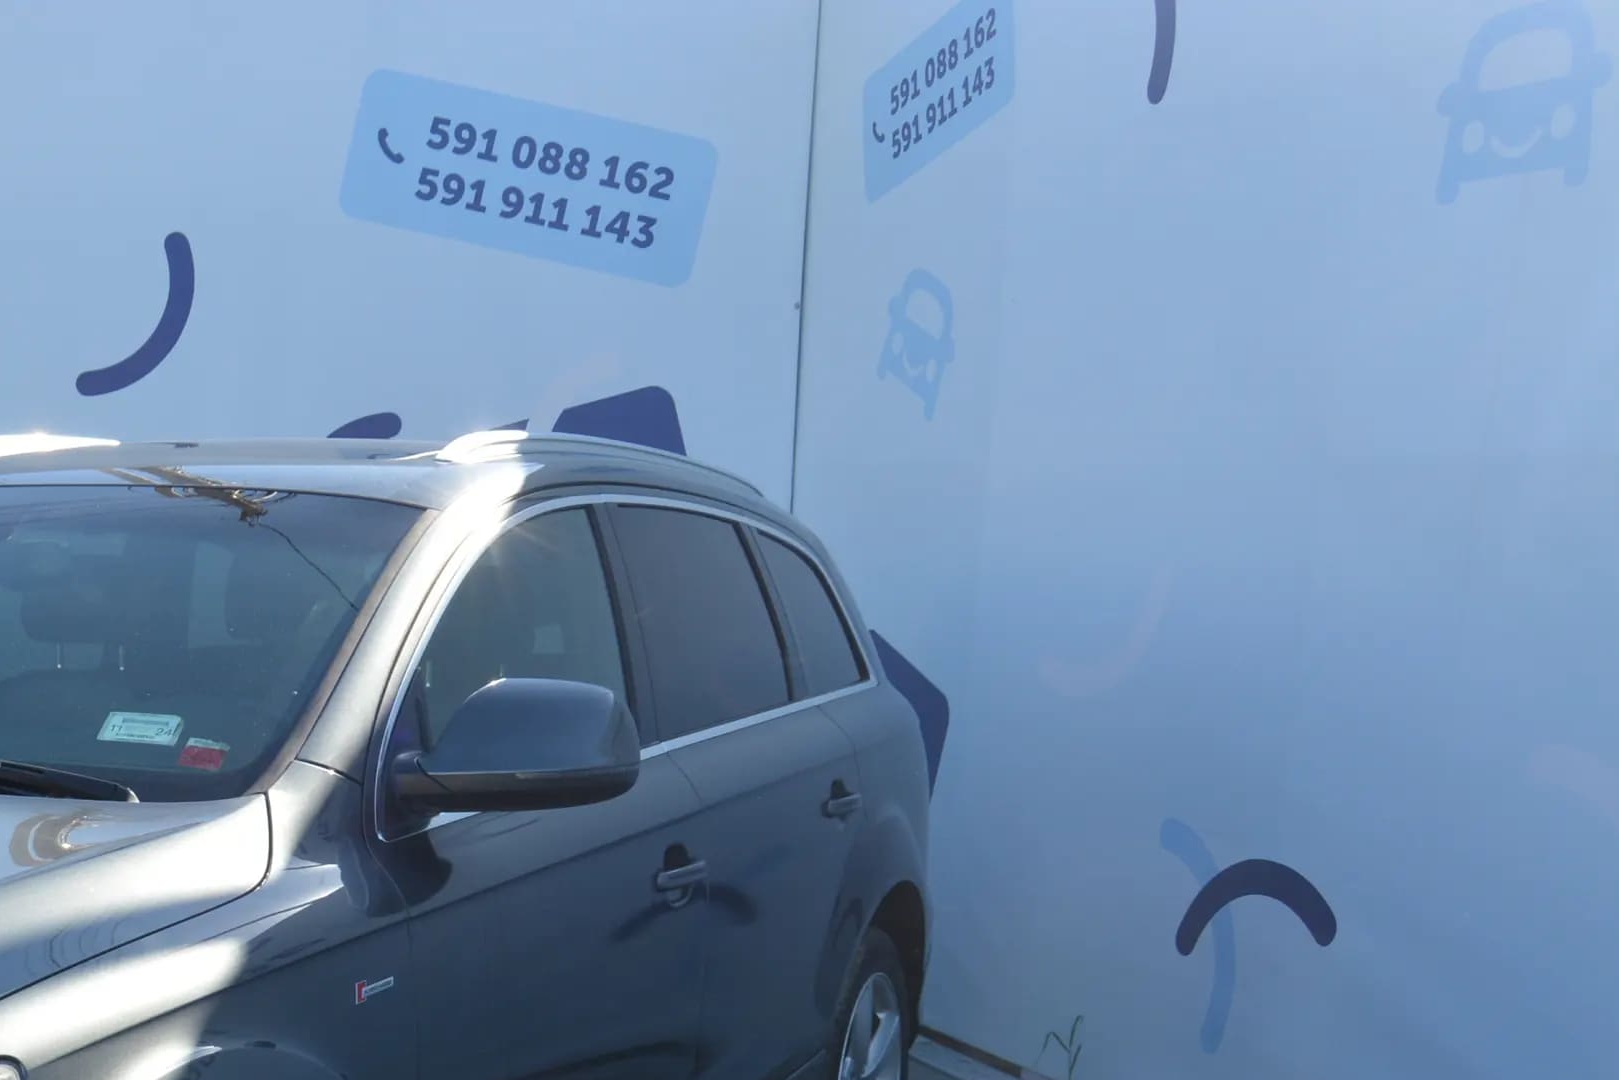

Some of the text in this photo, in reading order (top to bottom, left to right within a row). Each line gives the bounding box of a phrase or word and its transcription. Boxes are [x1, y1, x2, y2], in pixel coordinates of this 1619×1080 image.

[890, 7, 997, 116] 591 088 162
[891, 56, 995, 160] 591 911 143
[426, 116, 675, 201] 591 088 162
[414, 167, 658, 249] 591 911 143
